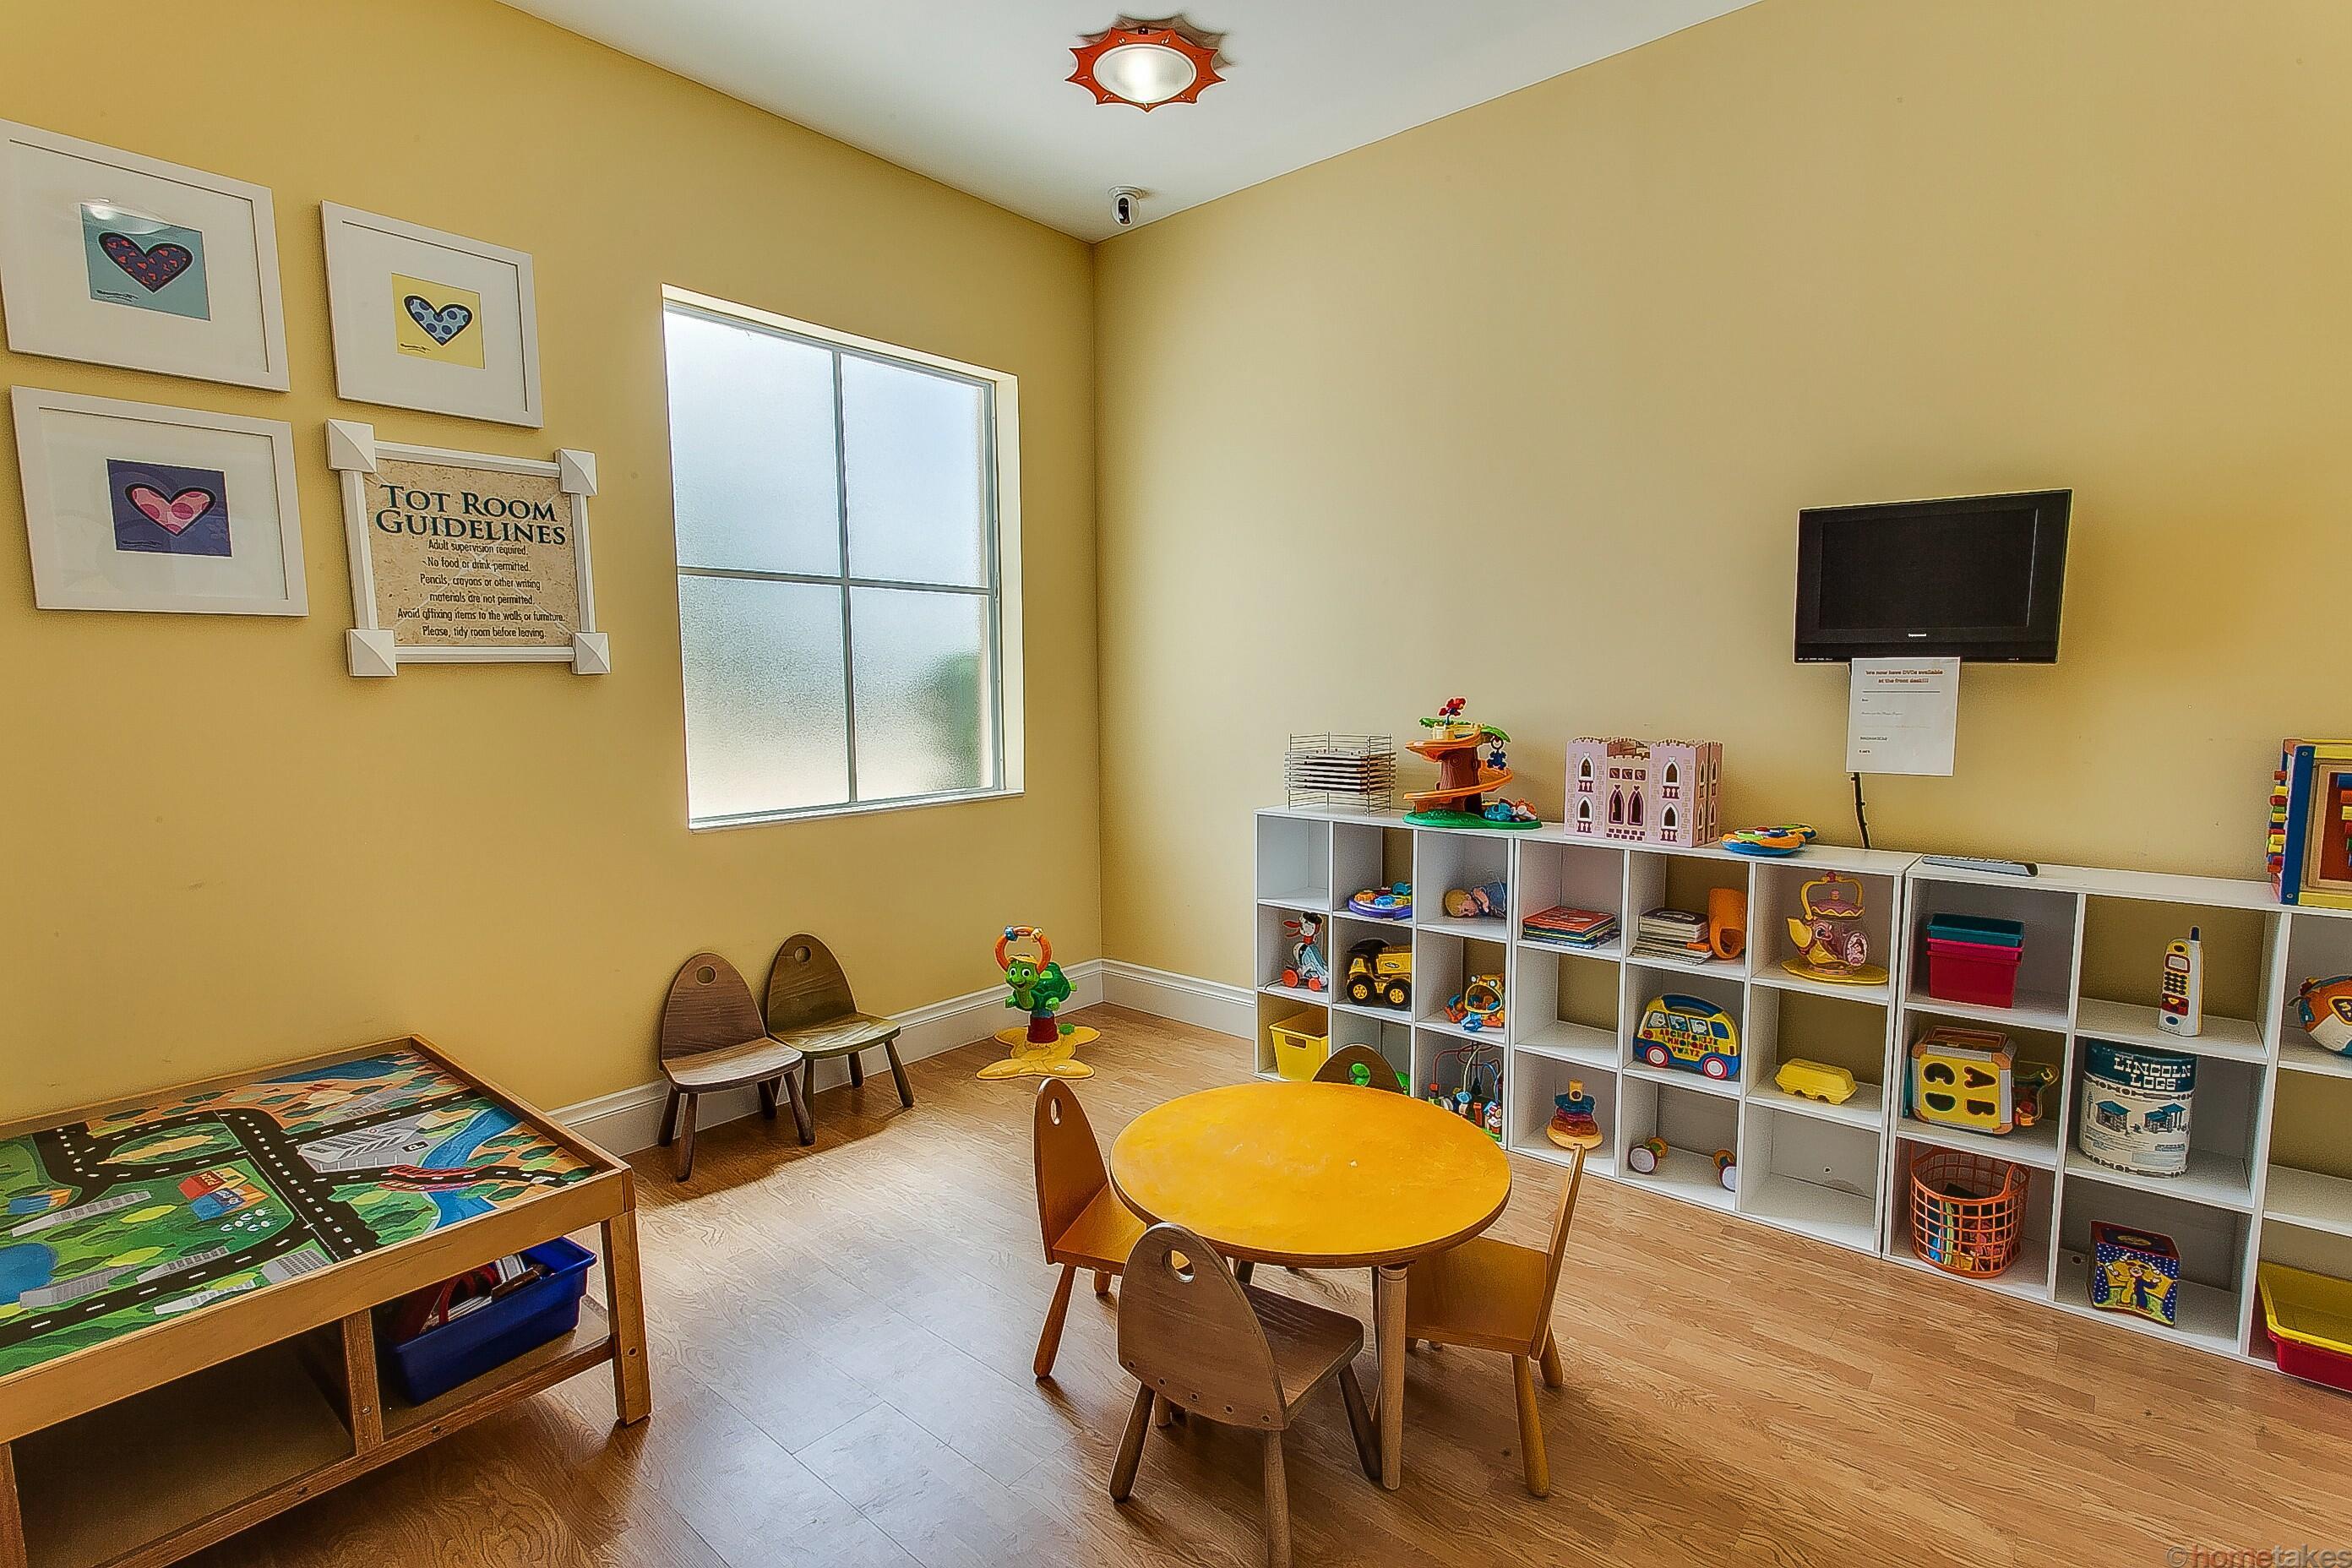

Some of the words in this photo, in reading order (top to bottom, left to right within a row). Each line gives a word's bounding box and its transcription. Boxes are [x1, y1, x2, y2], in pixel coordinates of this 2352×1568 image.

[380, 484, 450, 513] TOT
[460, 491, 558, 522] ROOM
[375, 509, 566, 545] GUIDELINES
[428, 539, 449, 550] Adult
[451, 543, 493, 553] supervision
[496, 545, 528, 556] required.
[427, 557, 438, 567] No
[441, 557, 460, 569] food
[462, 560, 470, 569] or
[472, 558, 492, 569] drink
[493, 561, 531, 572] permitted.
[420, 574, 450, 586] Pencils,
[453, 577, 482, 588] crayons
[484, 579, 492, 587] or
[494, 577, 514, 587] other
[515, 579, 541, 591] writing
[430, 592, 465, 603] materials
[468, 595, 481, 603] are
[483, 594, 495, 604] not
[498, 594, 535, 606] permitted.
[398, 607, 420, 618] Avoid
[422, 608, 452, 621] affixing
[455, 608, 476, 620] items
[478, 611, 486, 620] to
[488, 610, 500, 621] the
[422, 626, 451, 638] Please,
[454, 627, 468, 639] tidy
[471, 629, 491, 637] room
[493, 627, 516, 637] before
[519, 627, 547, 639] leaving.
[2114, 1057, 2191, 1077] LINCOLN
[2130, 1074, 2176, 1090] LOGS
